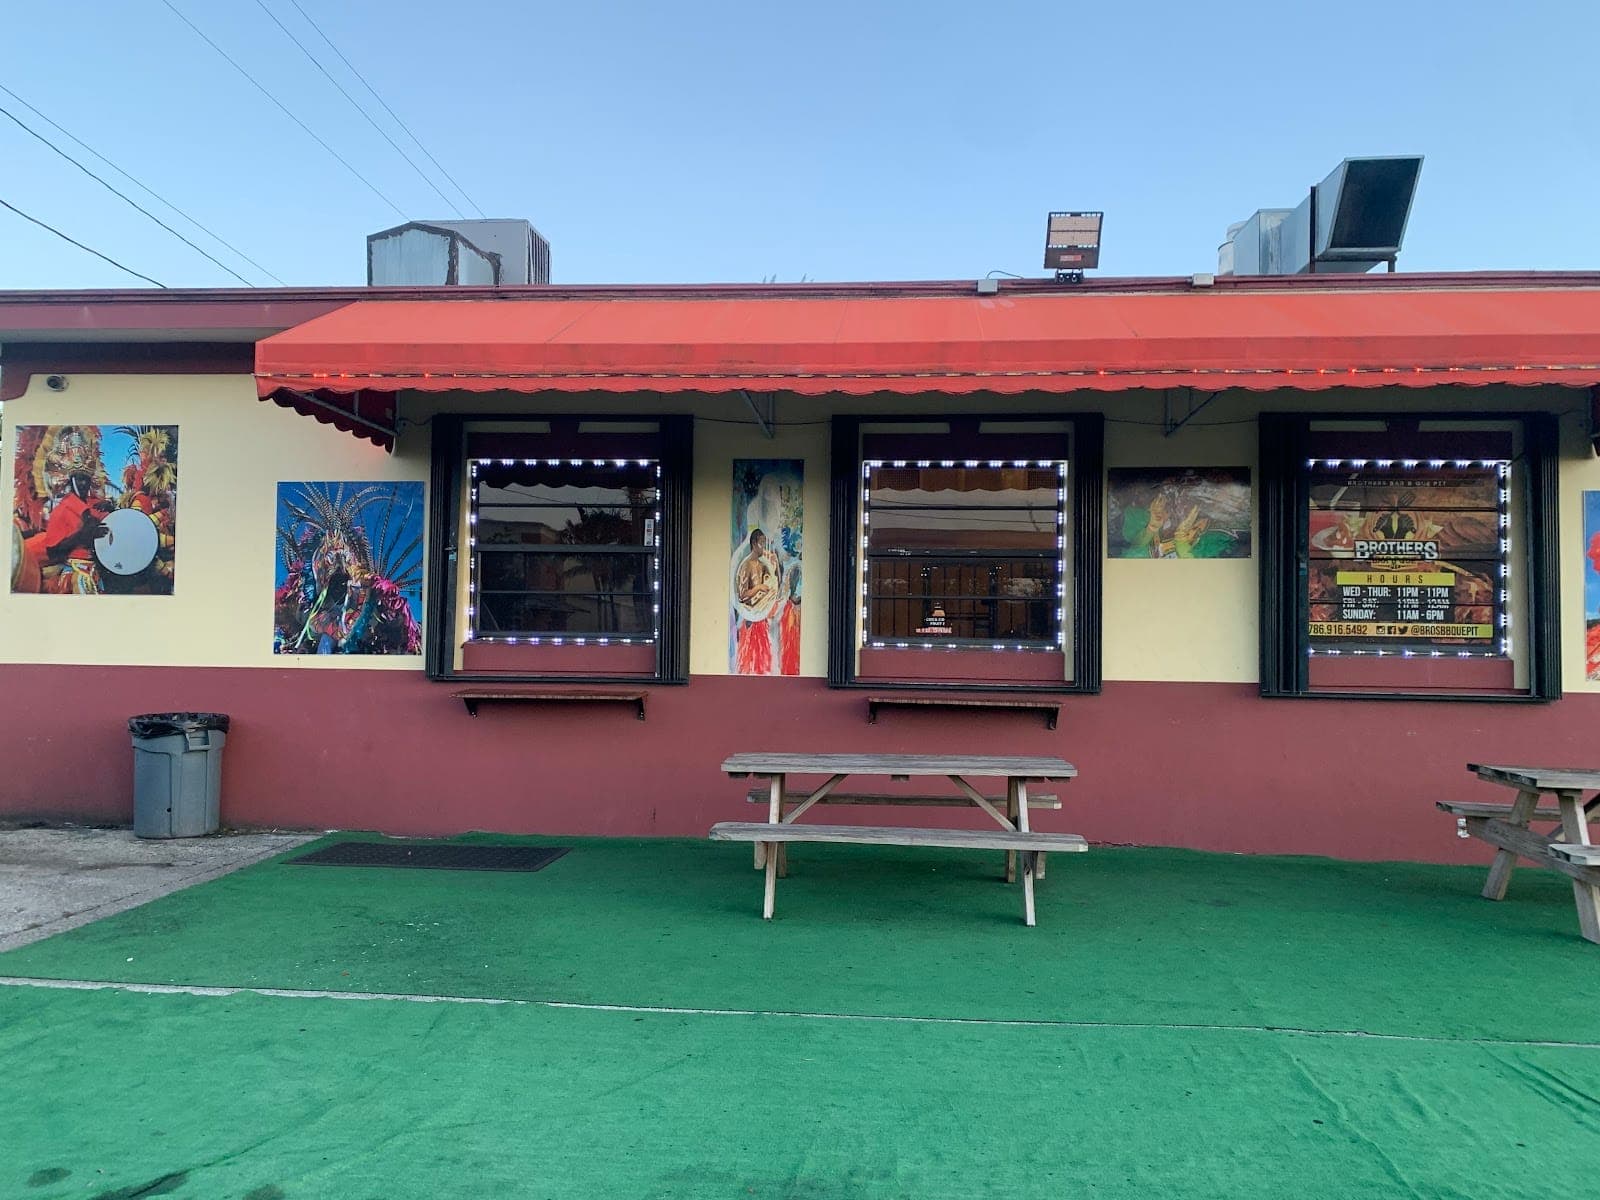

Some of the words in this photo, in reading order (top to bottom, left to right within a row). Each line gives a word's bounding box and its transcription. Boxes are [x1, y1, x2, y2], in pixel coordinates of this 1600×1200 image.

[1354, 540, 1439, 562] BROTHERS
[1366, 574, 1424, 584] HOURS
[1342, 586, 1361, 597] WED
[1368, 586, 1392, 597] THUR:
[1396, 587, 1419, 598] 11PM
[1427, 587, 1449, 598] 11PM
[1342, 609, 1376, 620] SUNDAY:
[1397, 610, 1420, 621] 11AM
[1426, 610, 1445, 621] 6PM
